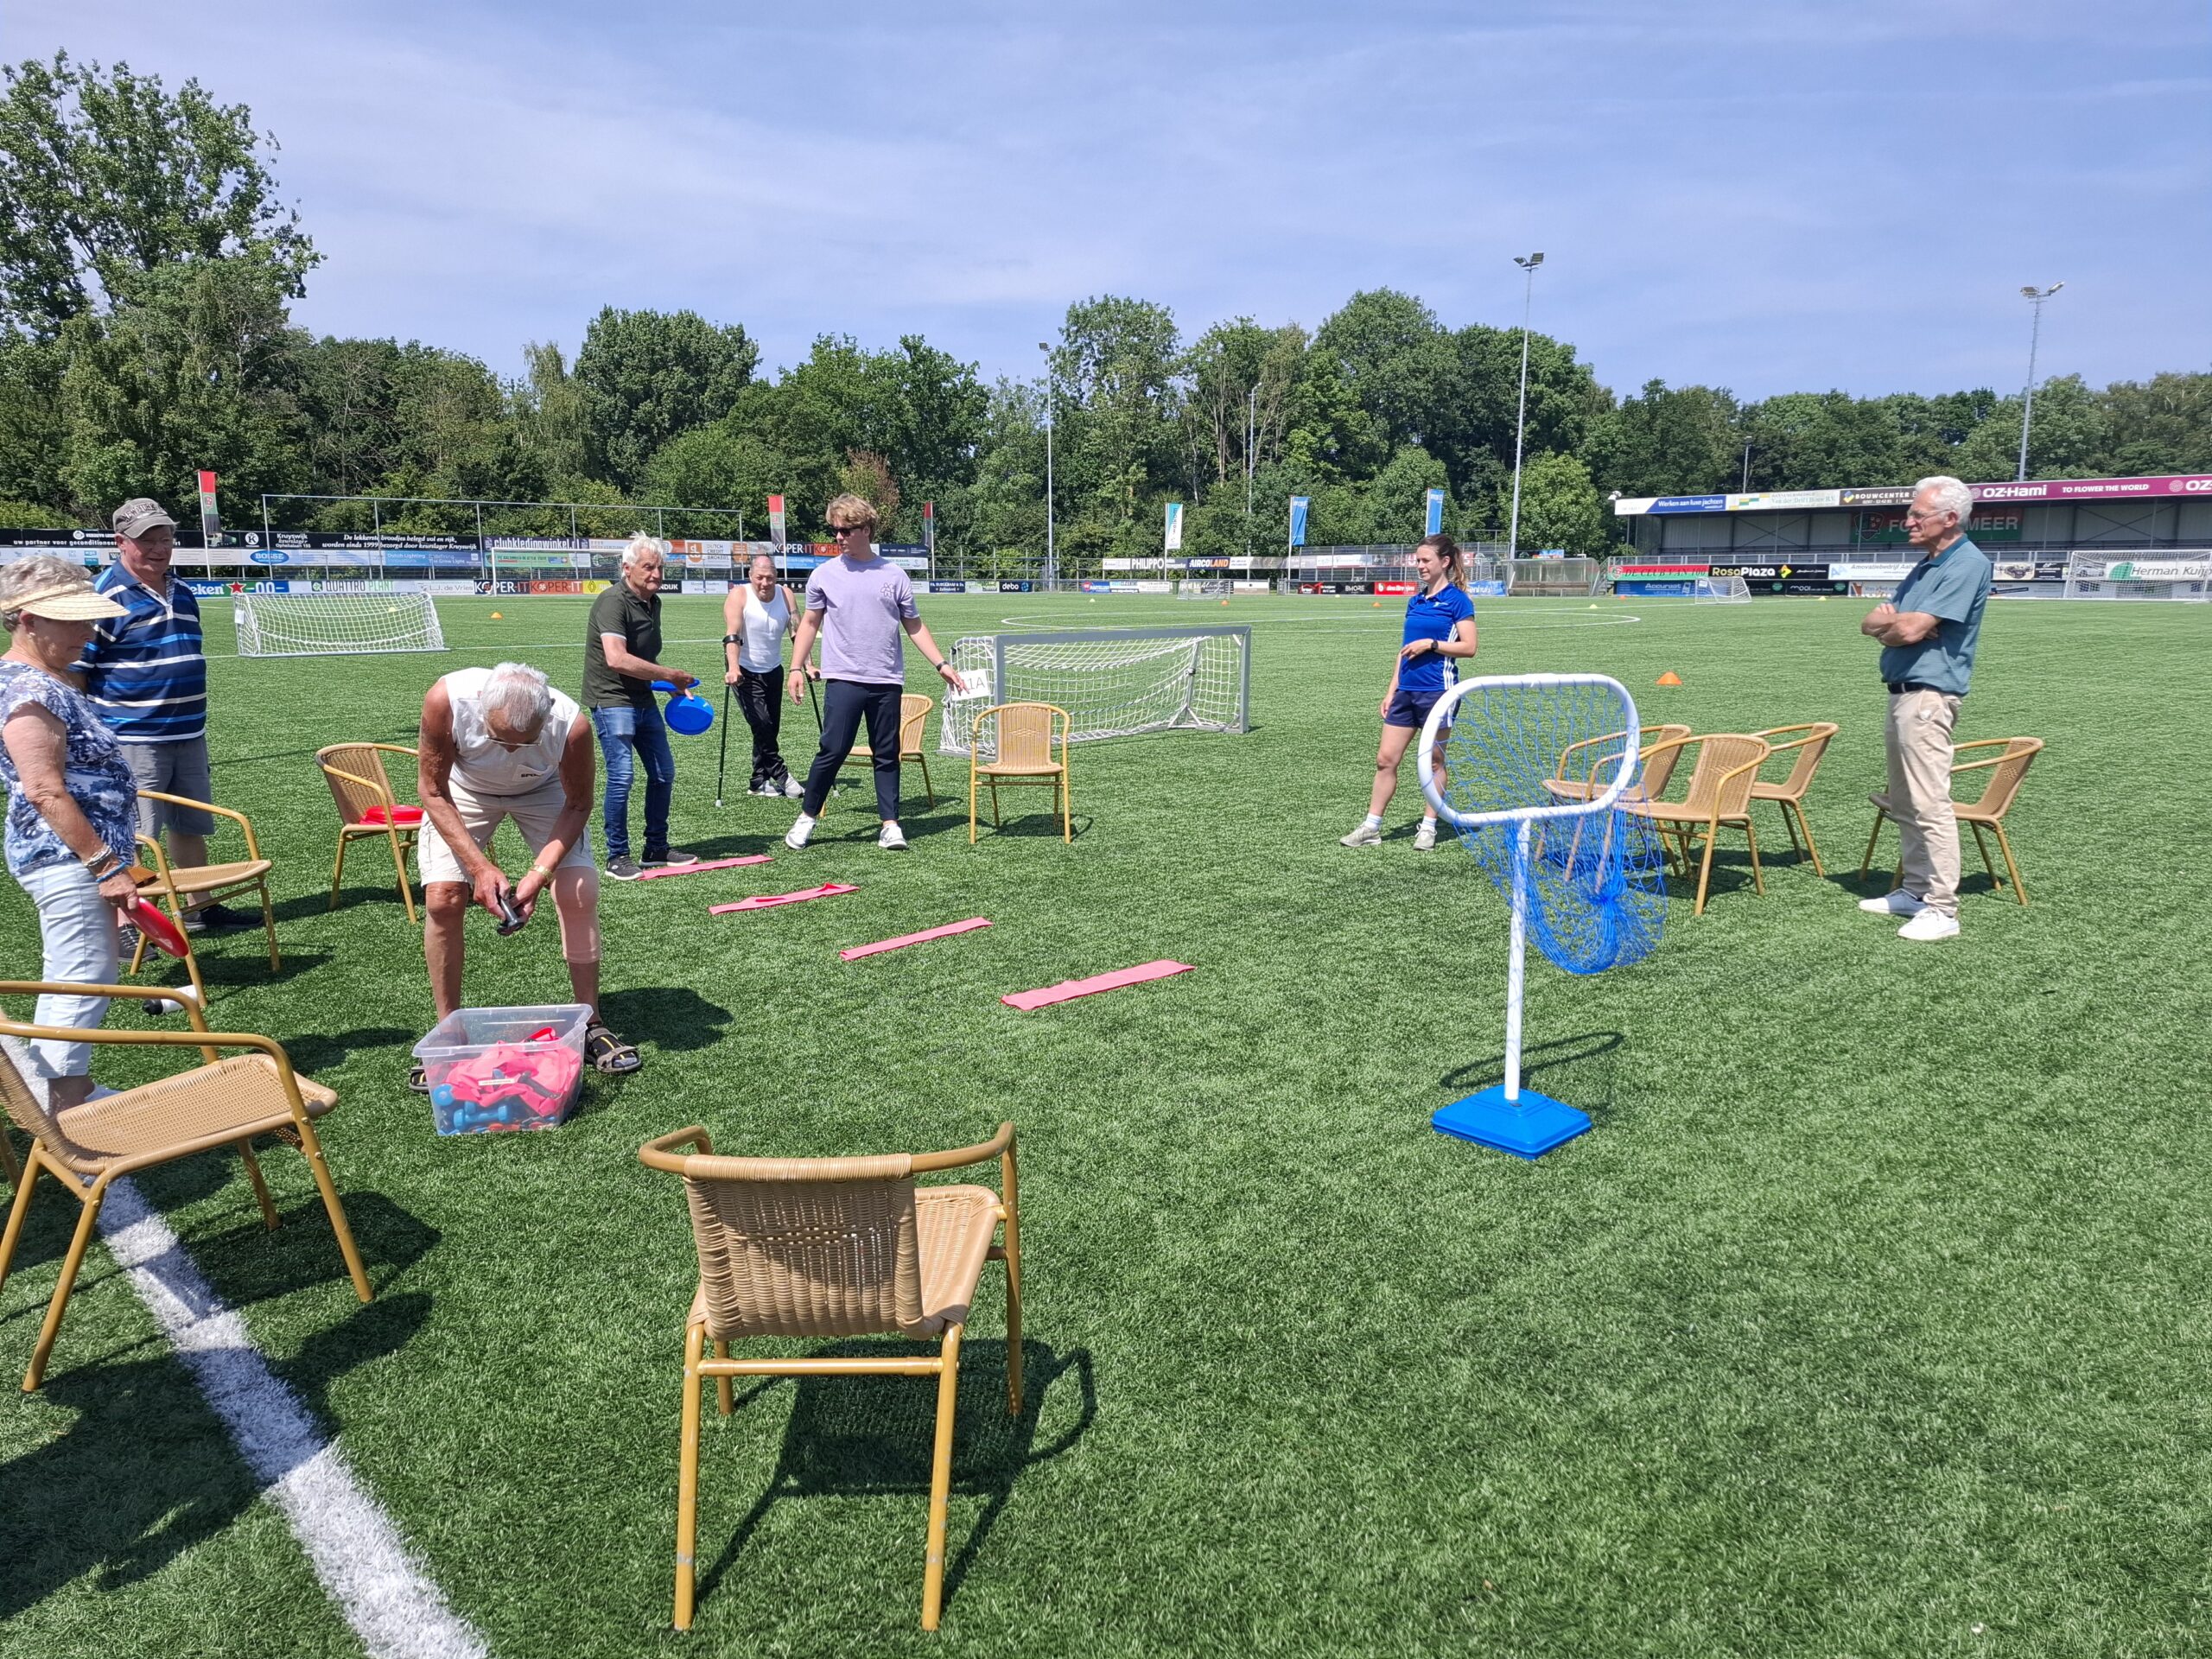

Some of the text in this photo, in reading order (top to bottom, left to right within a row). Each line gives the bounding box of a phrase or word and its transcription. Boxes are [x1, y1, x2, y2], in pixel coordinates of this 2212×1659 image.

[1131, 558, 1165, 569] PHILIPPO
[1189, 559, 1229, 568] AIRCOLAND
[1624, 569, 1637, 577] DE
[1640, 569, 1665, 577] CLUB
[1669, 568, 1688, 576] VAN
[1712, 567, 1776, 576] RosaPlaza
[2132, 566, 2177, 575] Herman
[326, 581, 394, 592] QUATTRO PLANT
